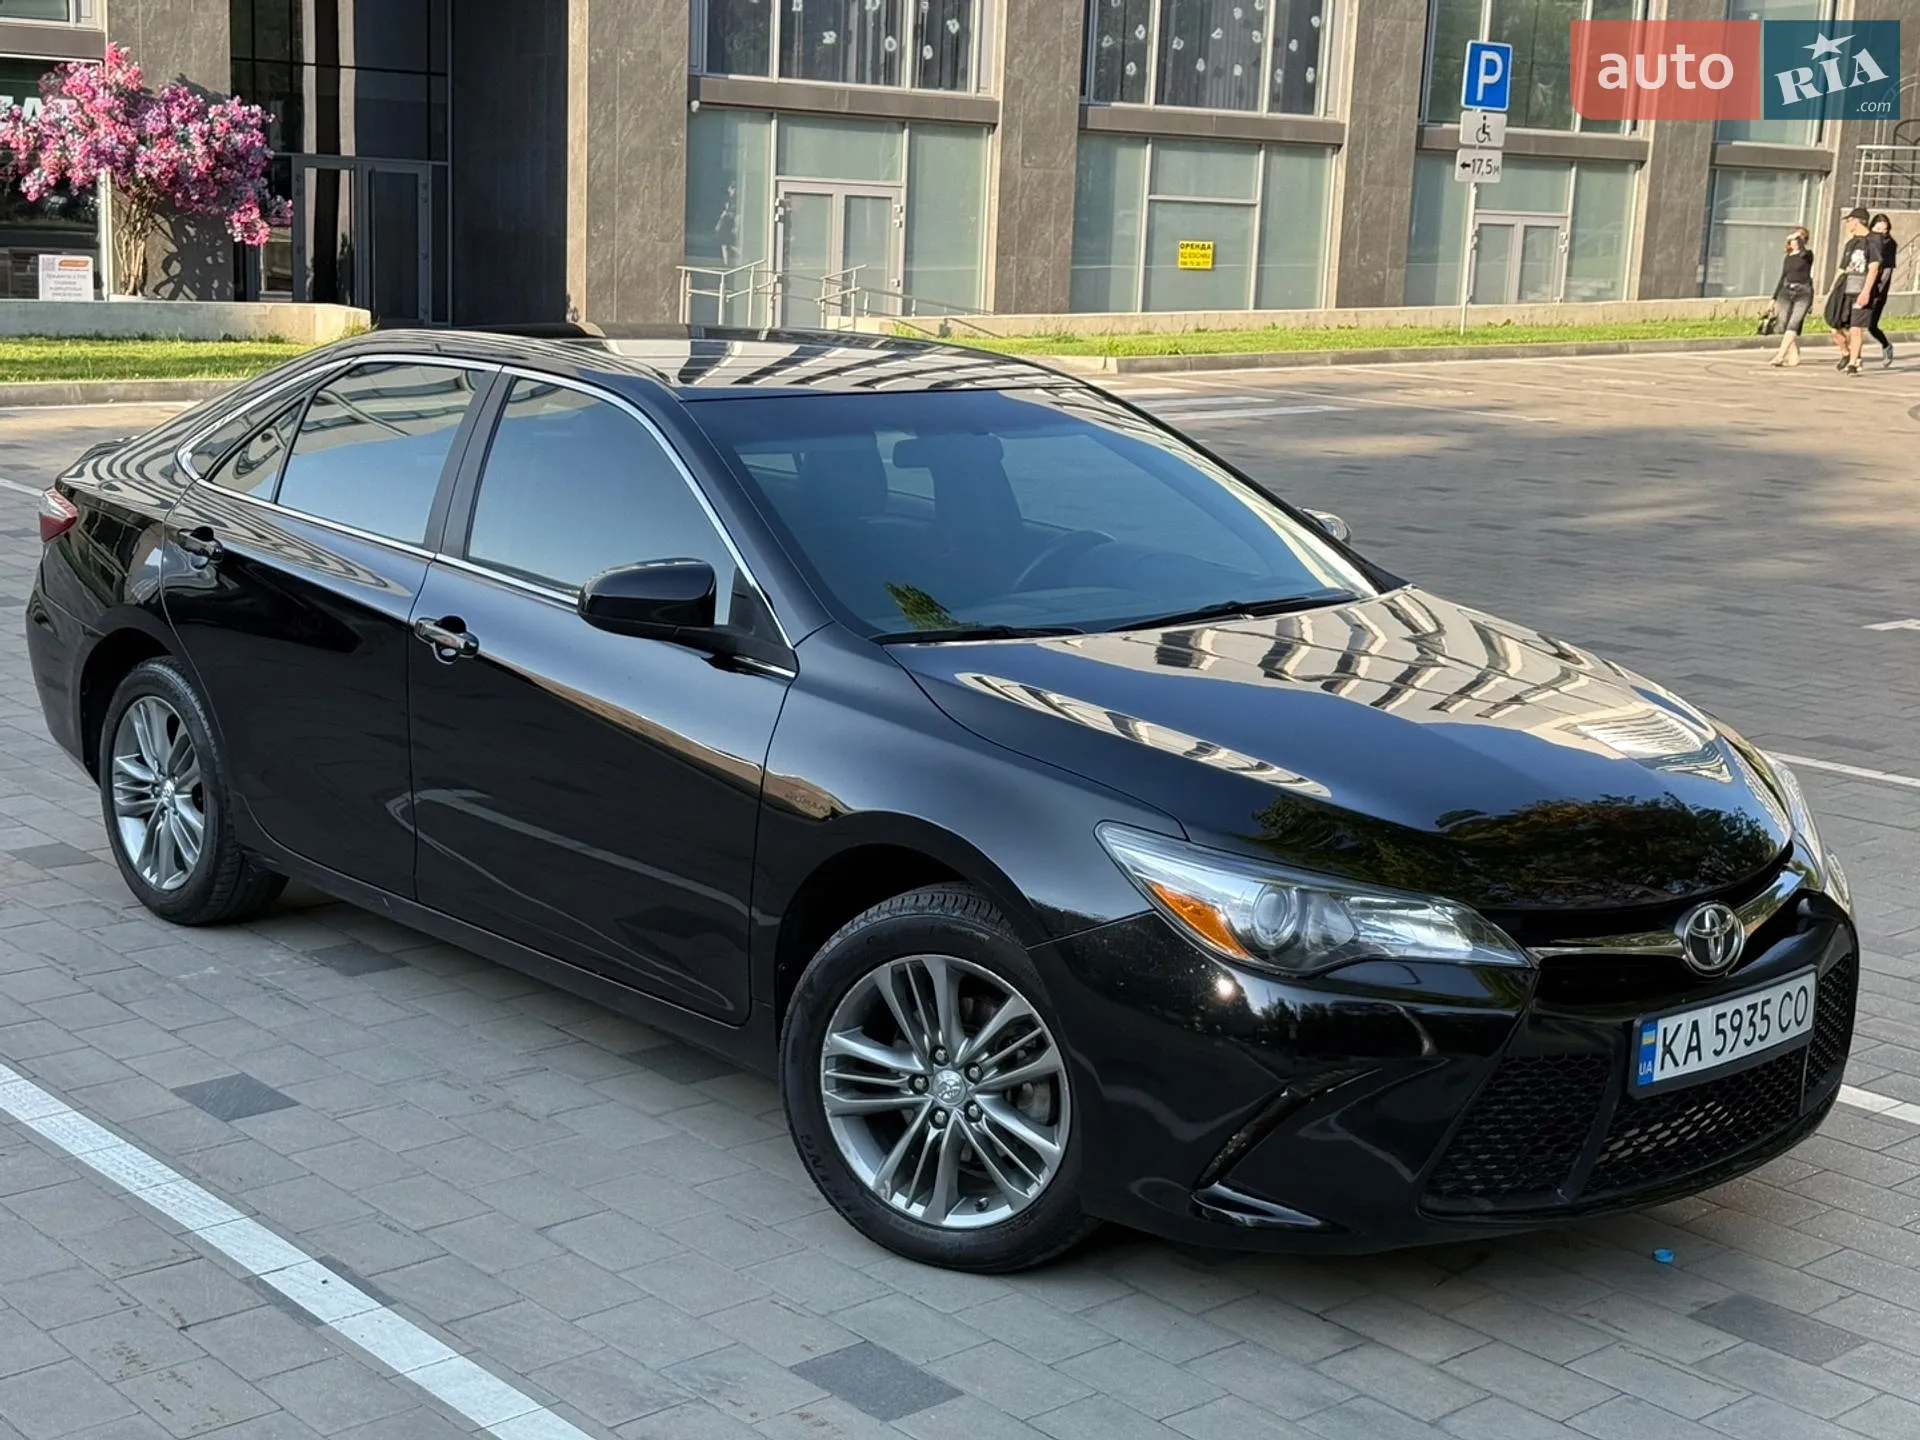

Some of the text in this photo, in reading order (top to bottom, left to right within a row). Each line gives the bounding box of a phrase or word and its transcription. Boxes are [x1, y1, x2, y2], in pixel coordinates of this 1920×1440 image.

[1476, 50, 1504, 102] P
[1180, 243, 1211, 251] ОРЕНДА
[1659, 985, 1809, 1072] KA 5935 CO
[1638, 1061, 1653, 1076] UA
